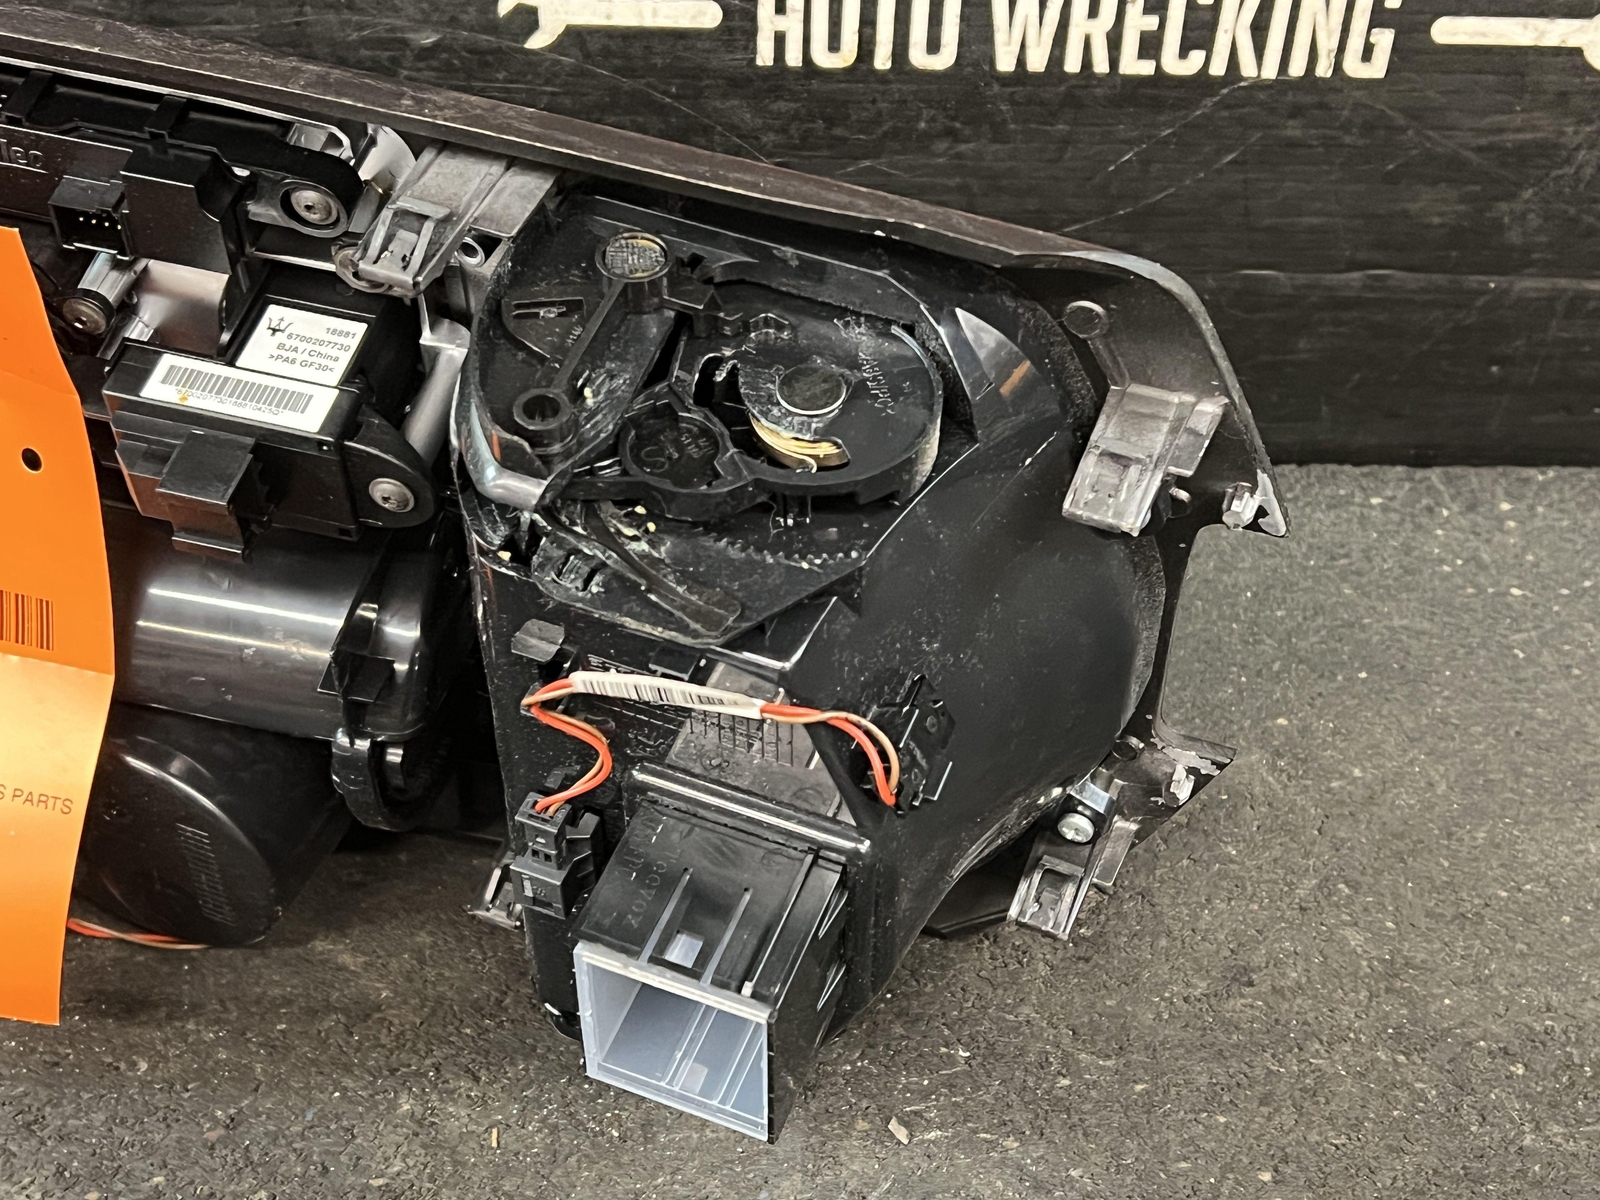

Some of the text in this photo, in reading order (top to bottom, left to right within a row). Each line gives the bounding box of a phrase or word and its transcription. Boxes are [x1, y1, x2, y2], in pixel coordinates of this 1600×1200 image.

[991, 0, 1401, 79] WRECKING
[286, 332, 351, 353] 6700207730
[325, 326, 357, 340] 18881
[276, 342, 299, 355] BJA
[308, 349, 340, 362] China
[11, 787, 74, 815] PARTS
